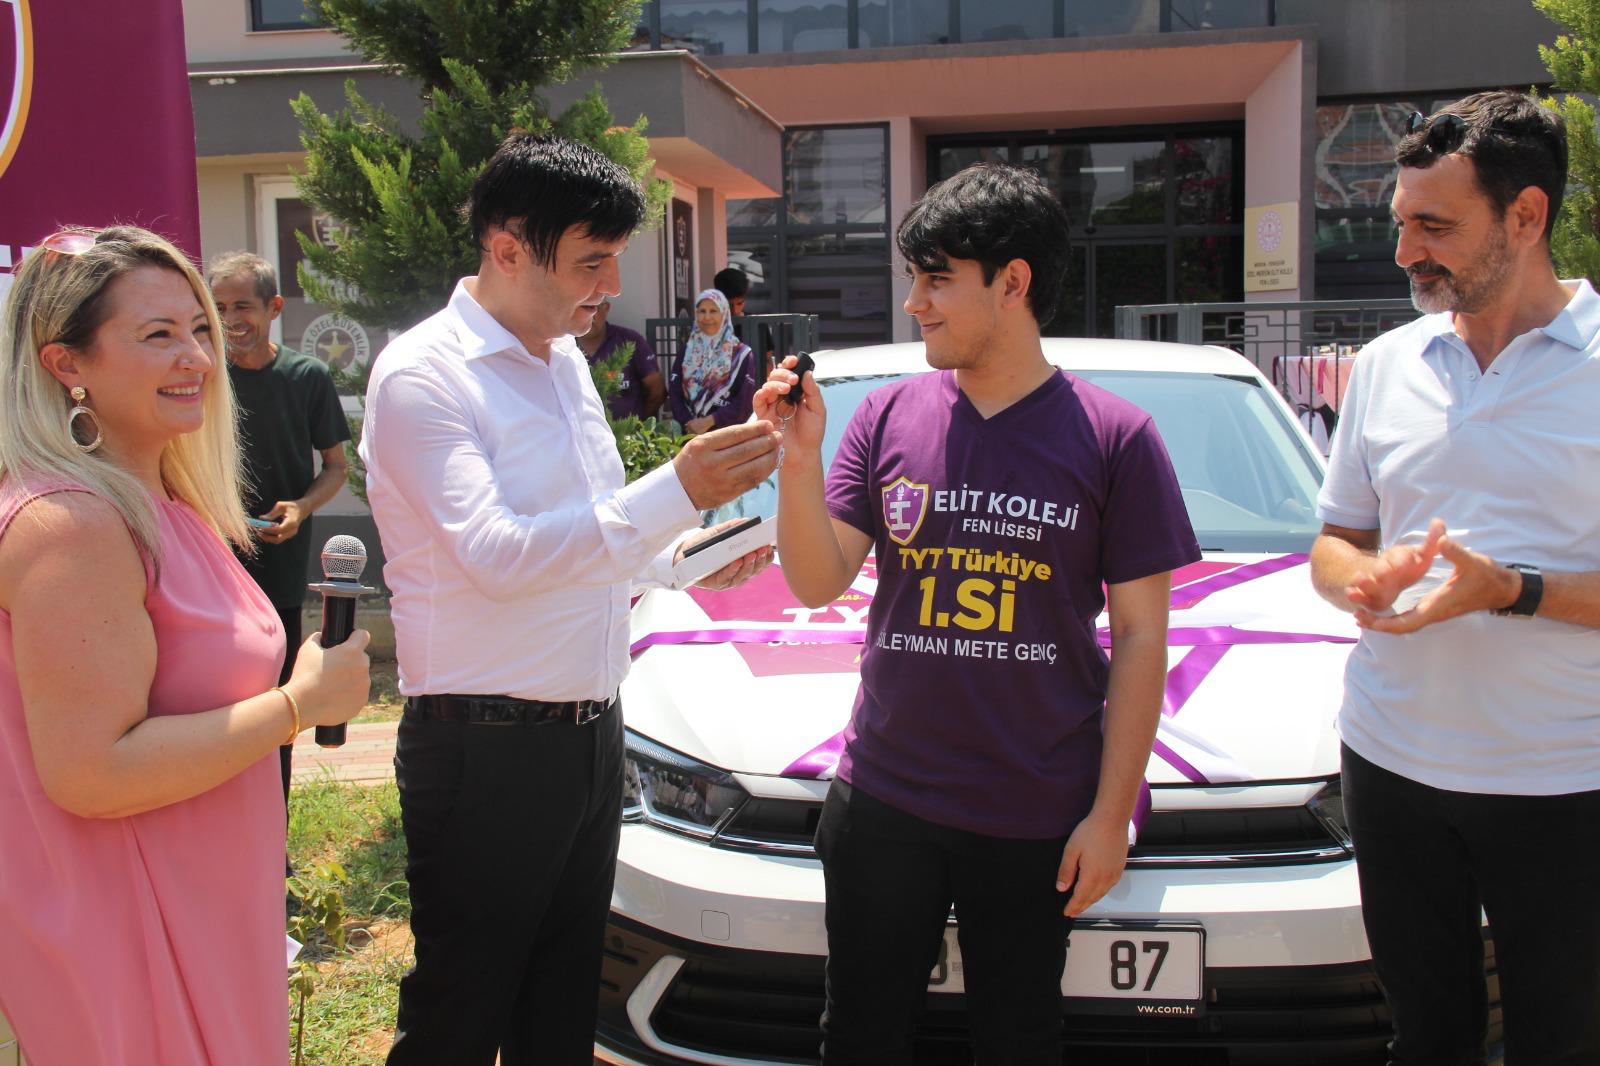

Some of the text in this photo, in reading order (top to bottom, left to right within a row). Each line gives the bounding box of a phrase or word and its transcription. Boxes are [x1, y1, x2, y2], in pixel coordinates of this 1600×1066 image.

[934, 483, 1080, 531] ELİT KOLEJİ
[962, 518, 1042, 542] FEN LİSESİ
[898, 547, 1051, 581] TYT Türkiye
[954, 639, 1008, 660] METE
[1014, 643, 1057, 664] GENÇ
[1110, 939, 1170, 991] 87
[1137, 1004, 1195, 1015] vw.com.tr
